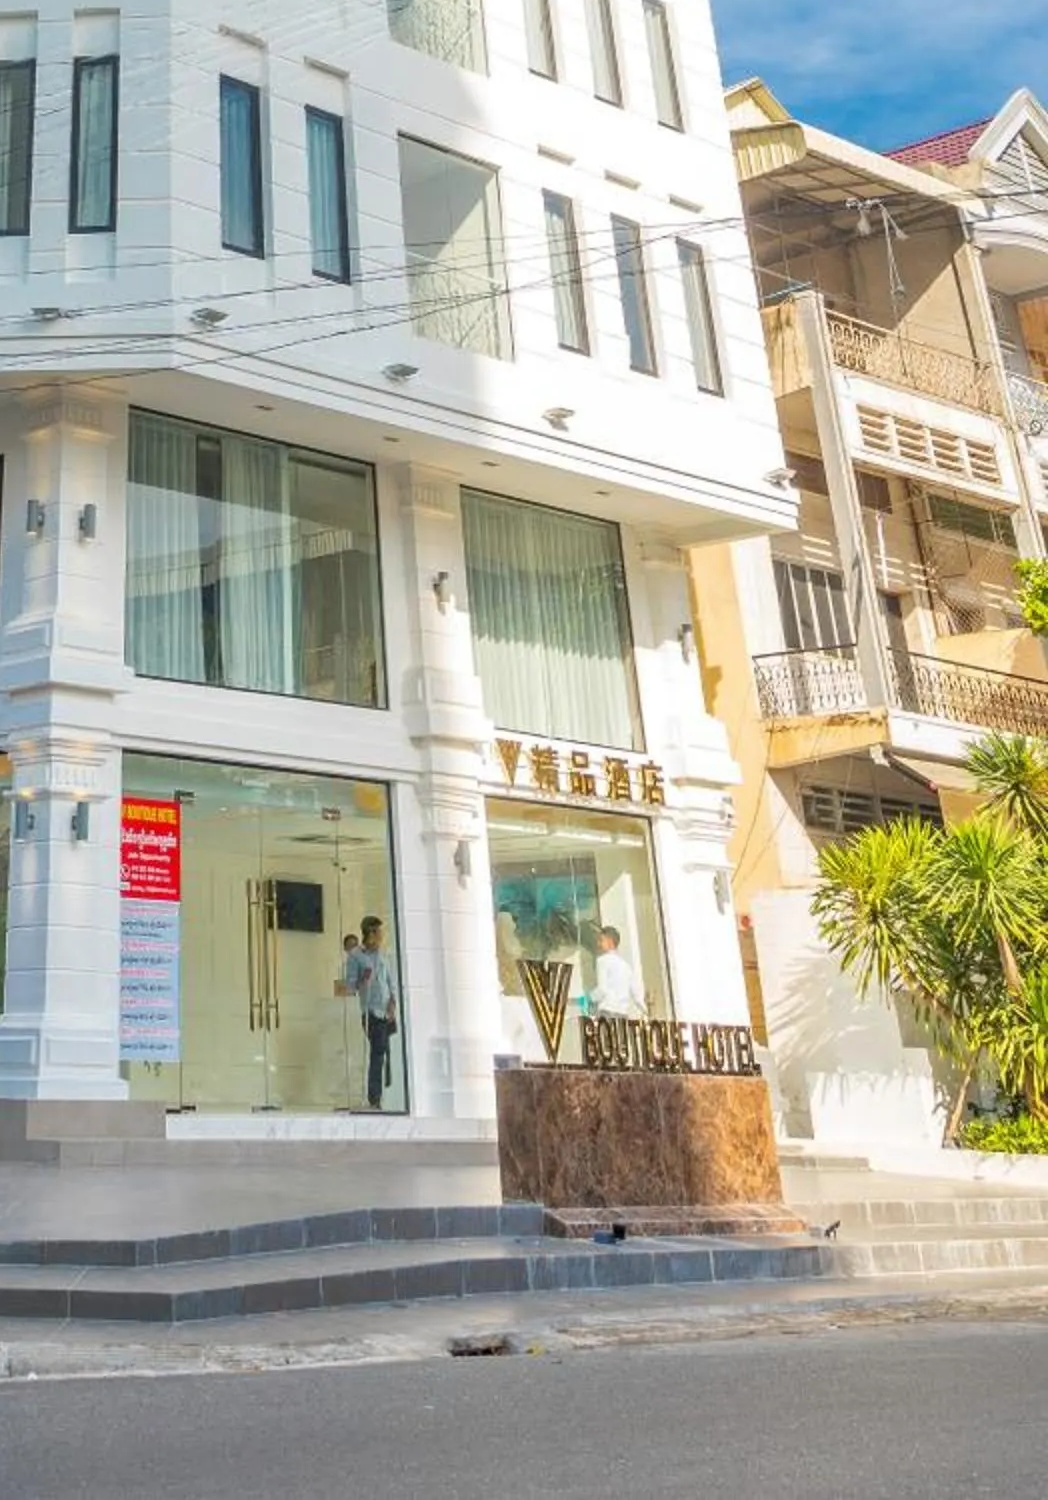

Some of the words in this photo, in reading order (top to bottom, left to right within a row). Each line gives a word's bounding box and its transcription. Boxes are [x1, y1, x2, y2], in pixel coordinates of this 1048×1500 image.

[531, 744, 665, 806] 精品酒店
[517, 960, 574, 1064] V
[579, 1016, 692, 1072] BOUTIQUE
[691, 1022, 761, 1077] HOTEL
